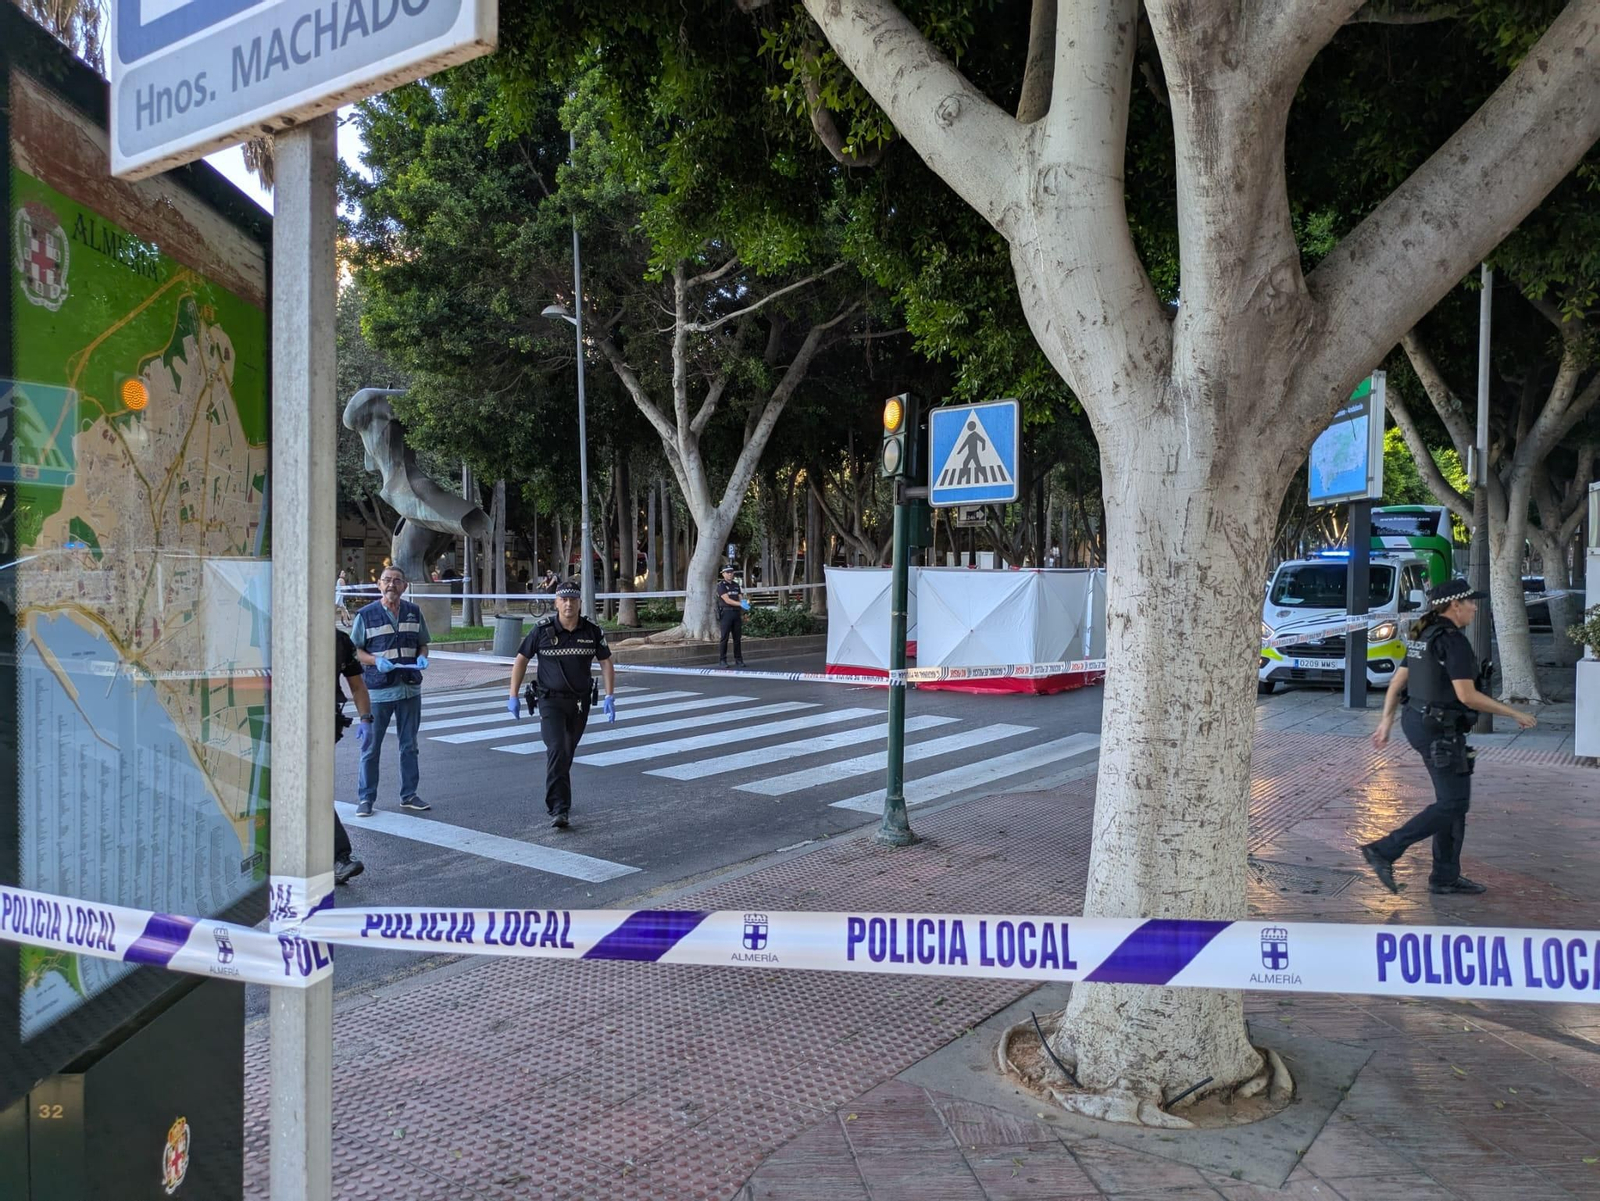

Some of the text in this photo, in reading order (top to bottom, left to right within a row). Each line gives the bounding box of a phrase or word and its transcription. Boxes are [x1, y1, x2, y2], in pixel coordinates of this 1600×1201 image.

[136, 71, 216, 132] Hnos.
[1299, 659, 1319, 668] 0209
[2, 892, 116, 952] POLICIA LOCAL
[361, 911, 574, 949] POLICIA LOCAL
[731, 952, 779, 963] ALMERÍA
[847, 917, 1077, 970] POLICIA LOCAL
[1376, 932, 1513, 987] POLICIA
[1249, 973, 1302, 985] ALMERÍA
[39, 1104, 64, 1119] 32
